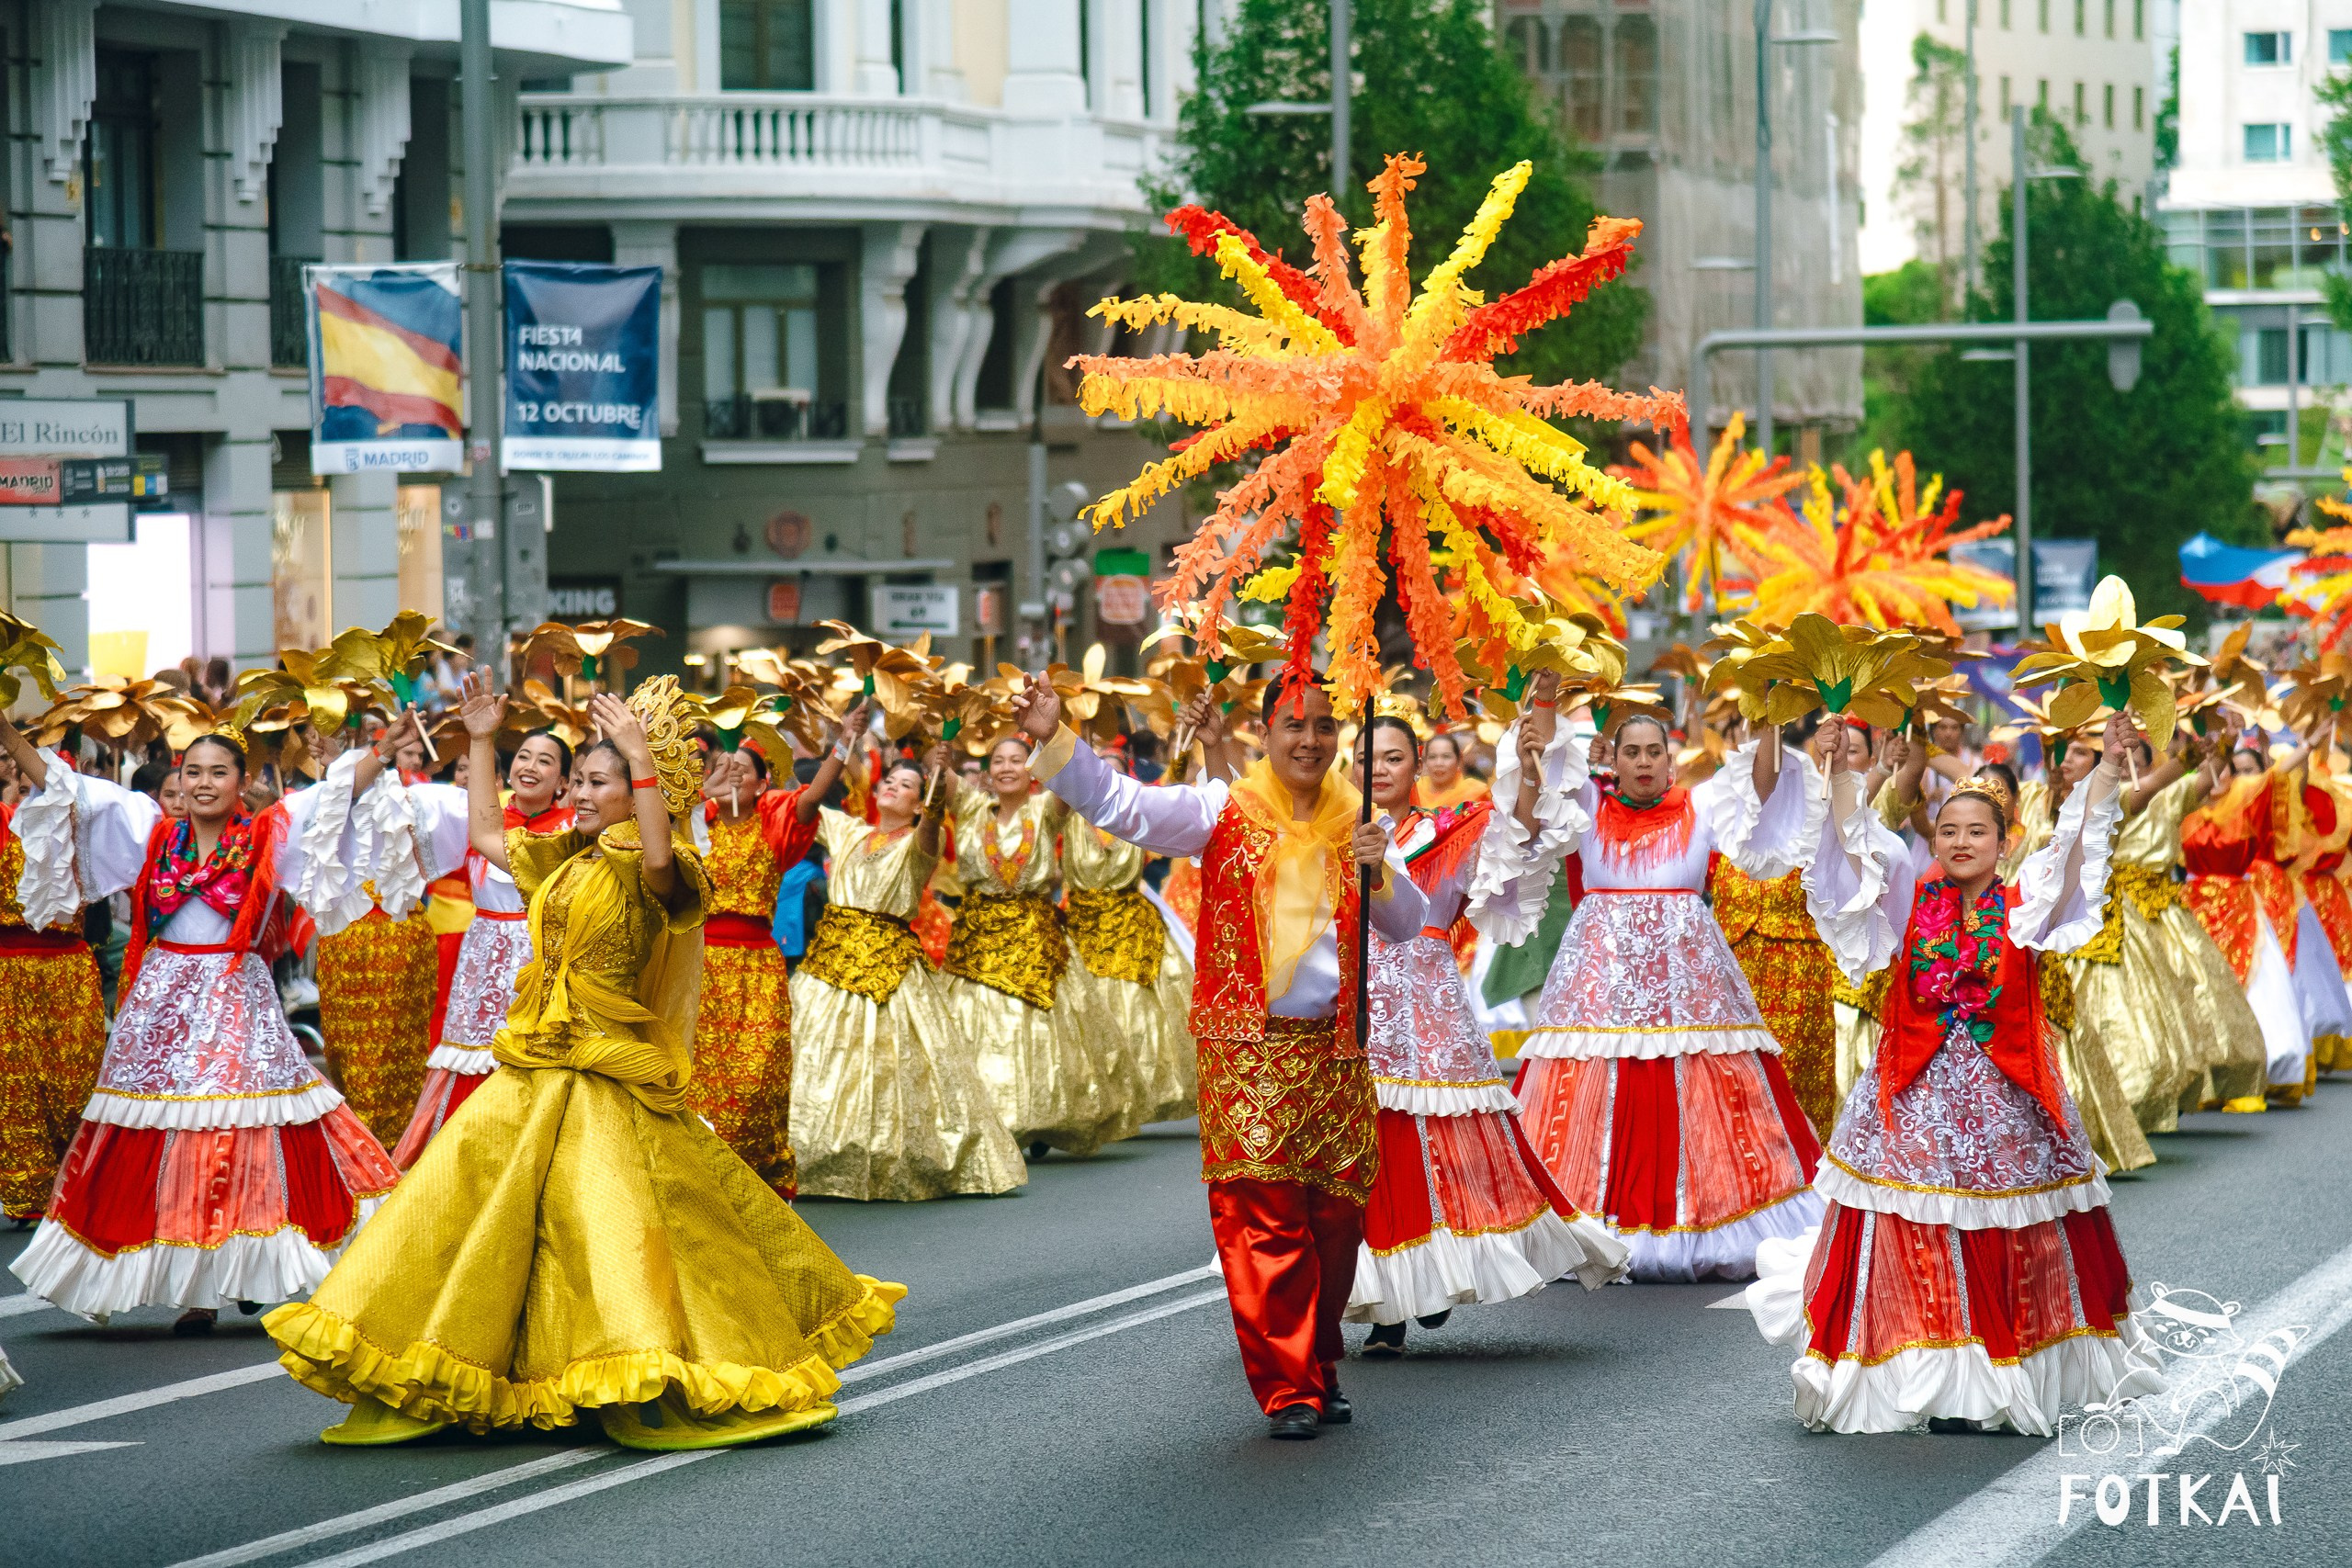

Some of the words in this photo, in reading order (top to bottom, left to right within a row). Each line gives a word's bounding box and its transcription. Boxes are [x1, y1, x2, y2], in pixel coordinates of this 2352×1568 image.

[518, 326, 582, 345] FIESTA
[517, 351, 627, 373] NACIONAL
[518, 402, 539, 423] 12
[543, 402, 641, 430] OCTUBRE
[1, 422, 25, 444] El
[35, 422, 119, 445] Rincón
[364, 451, 429, 467] MADRID
